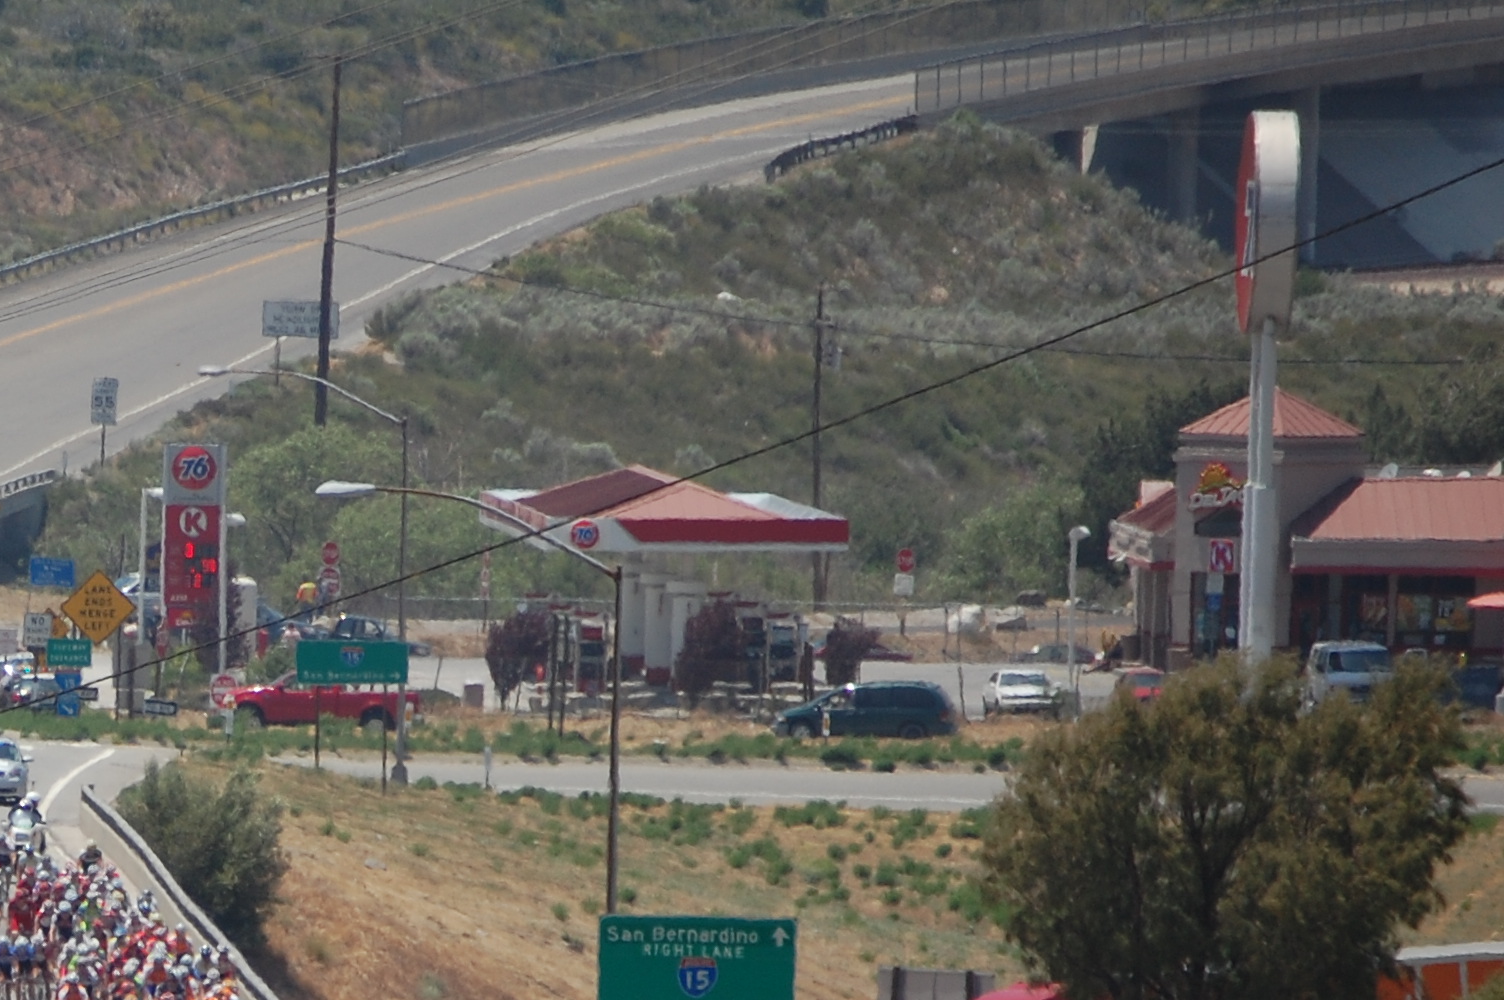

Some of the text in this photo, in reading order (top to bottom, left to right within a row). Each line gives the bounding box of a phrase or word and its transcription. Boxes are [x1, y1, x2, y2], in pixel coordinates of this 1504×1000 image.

[94, 395, 116, 409] 55
[178, 455, 210, 481] 76
[183, 509, 206, 536] K
[577, 526, 595, 543] 76
[84, 586, 112, 595] LANE
[31, 616, 45, 625] NO
[79, 608, 115, 618] MERGE
[84, 621, 111, 632] LEFT
[607, 925, 759, 944] San Bernardino
[644, 943, 745, 959] RIGHT LANE
[685, 970, 710, 990] 15
